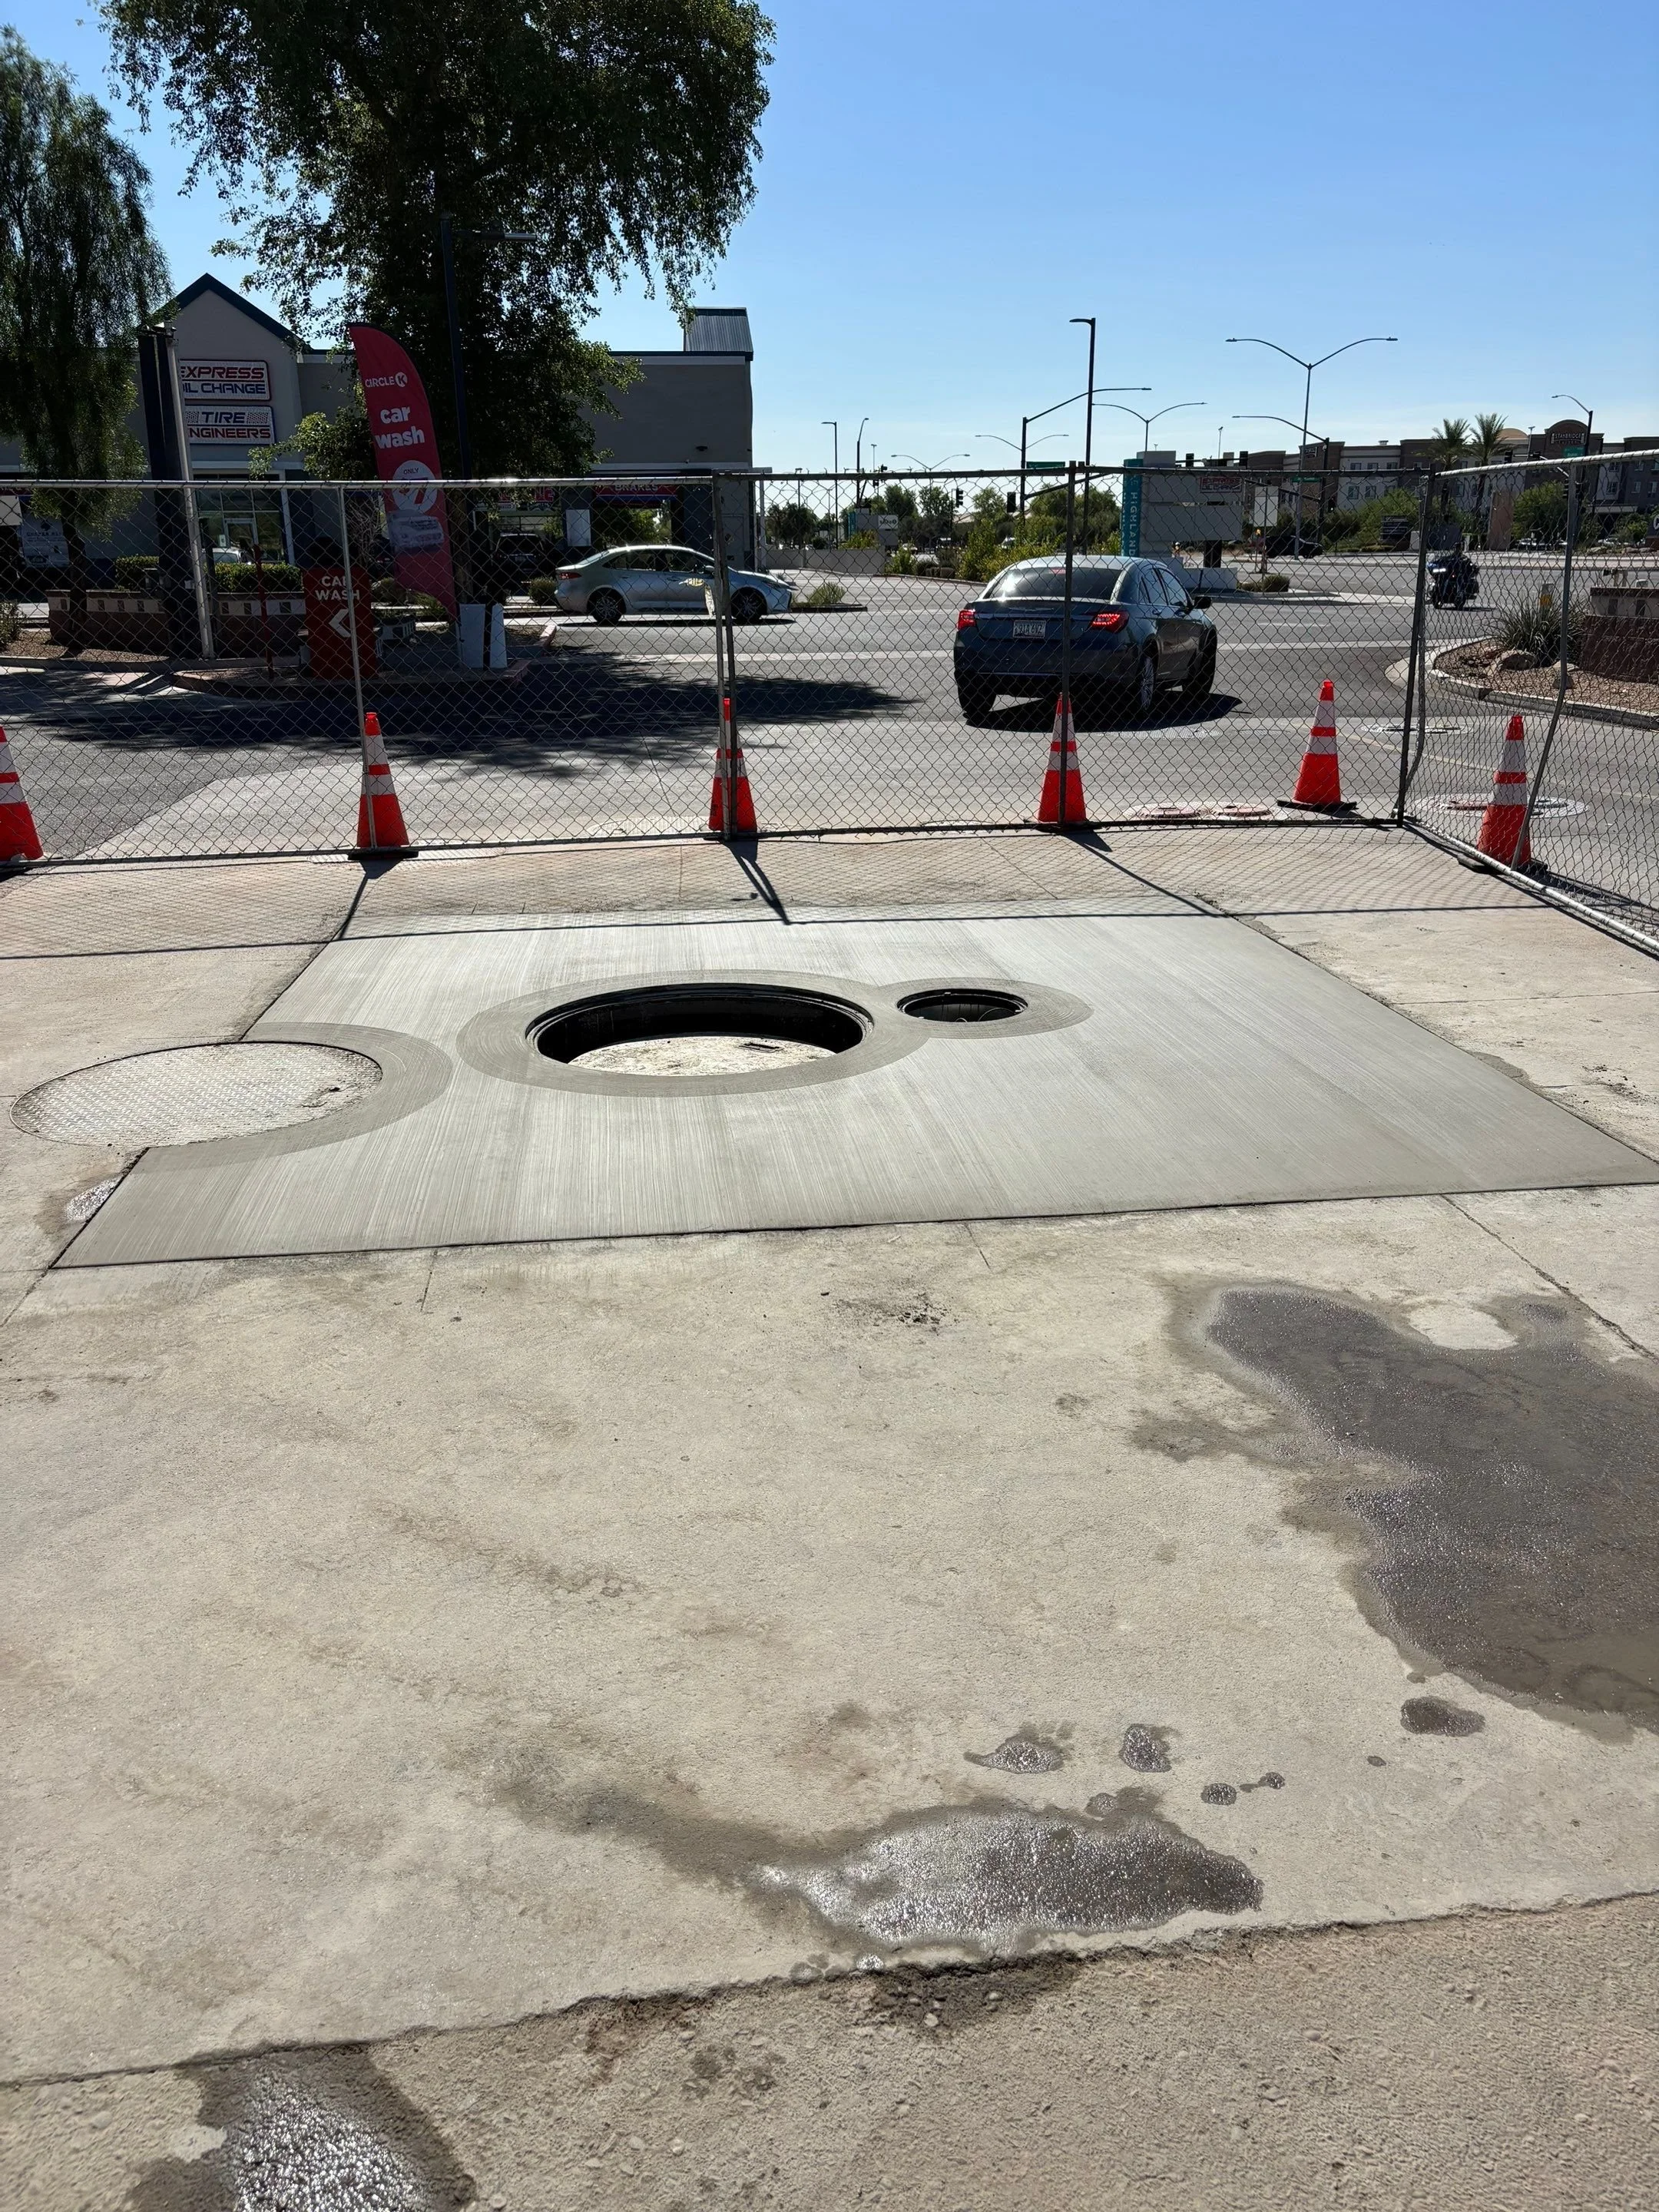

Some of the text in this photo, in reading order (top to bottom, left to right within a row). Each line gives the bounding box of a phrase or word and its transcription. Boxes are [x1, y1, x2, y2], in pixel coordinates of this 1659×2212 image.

[183, 382, 267, 394] IL CHANGE
[365, 376, 395, 388] CIRCLE
[201, 412, 246, 424] TIRE
[380, 406, 411, 424] car
[189, 428, 271, 439] NGINEERS
[375, 426, 426, 449] wash
